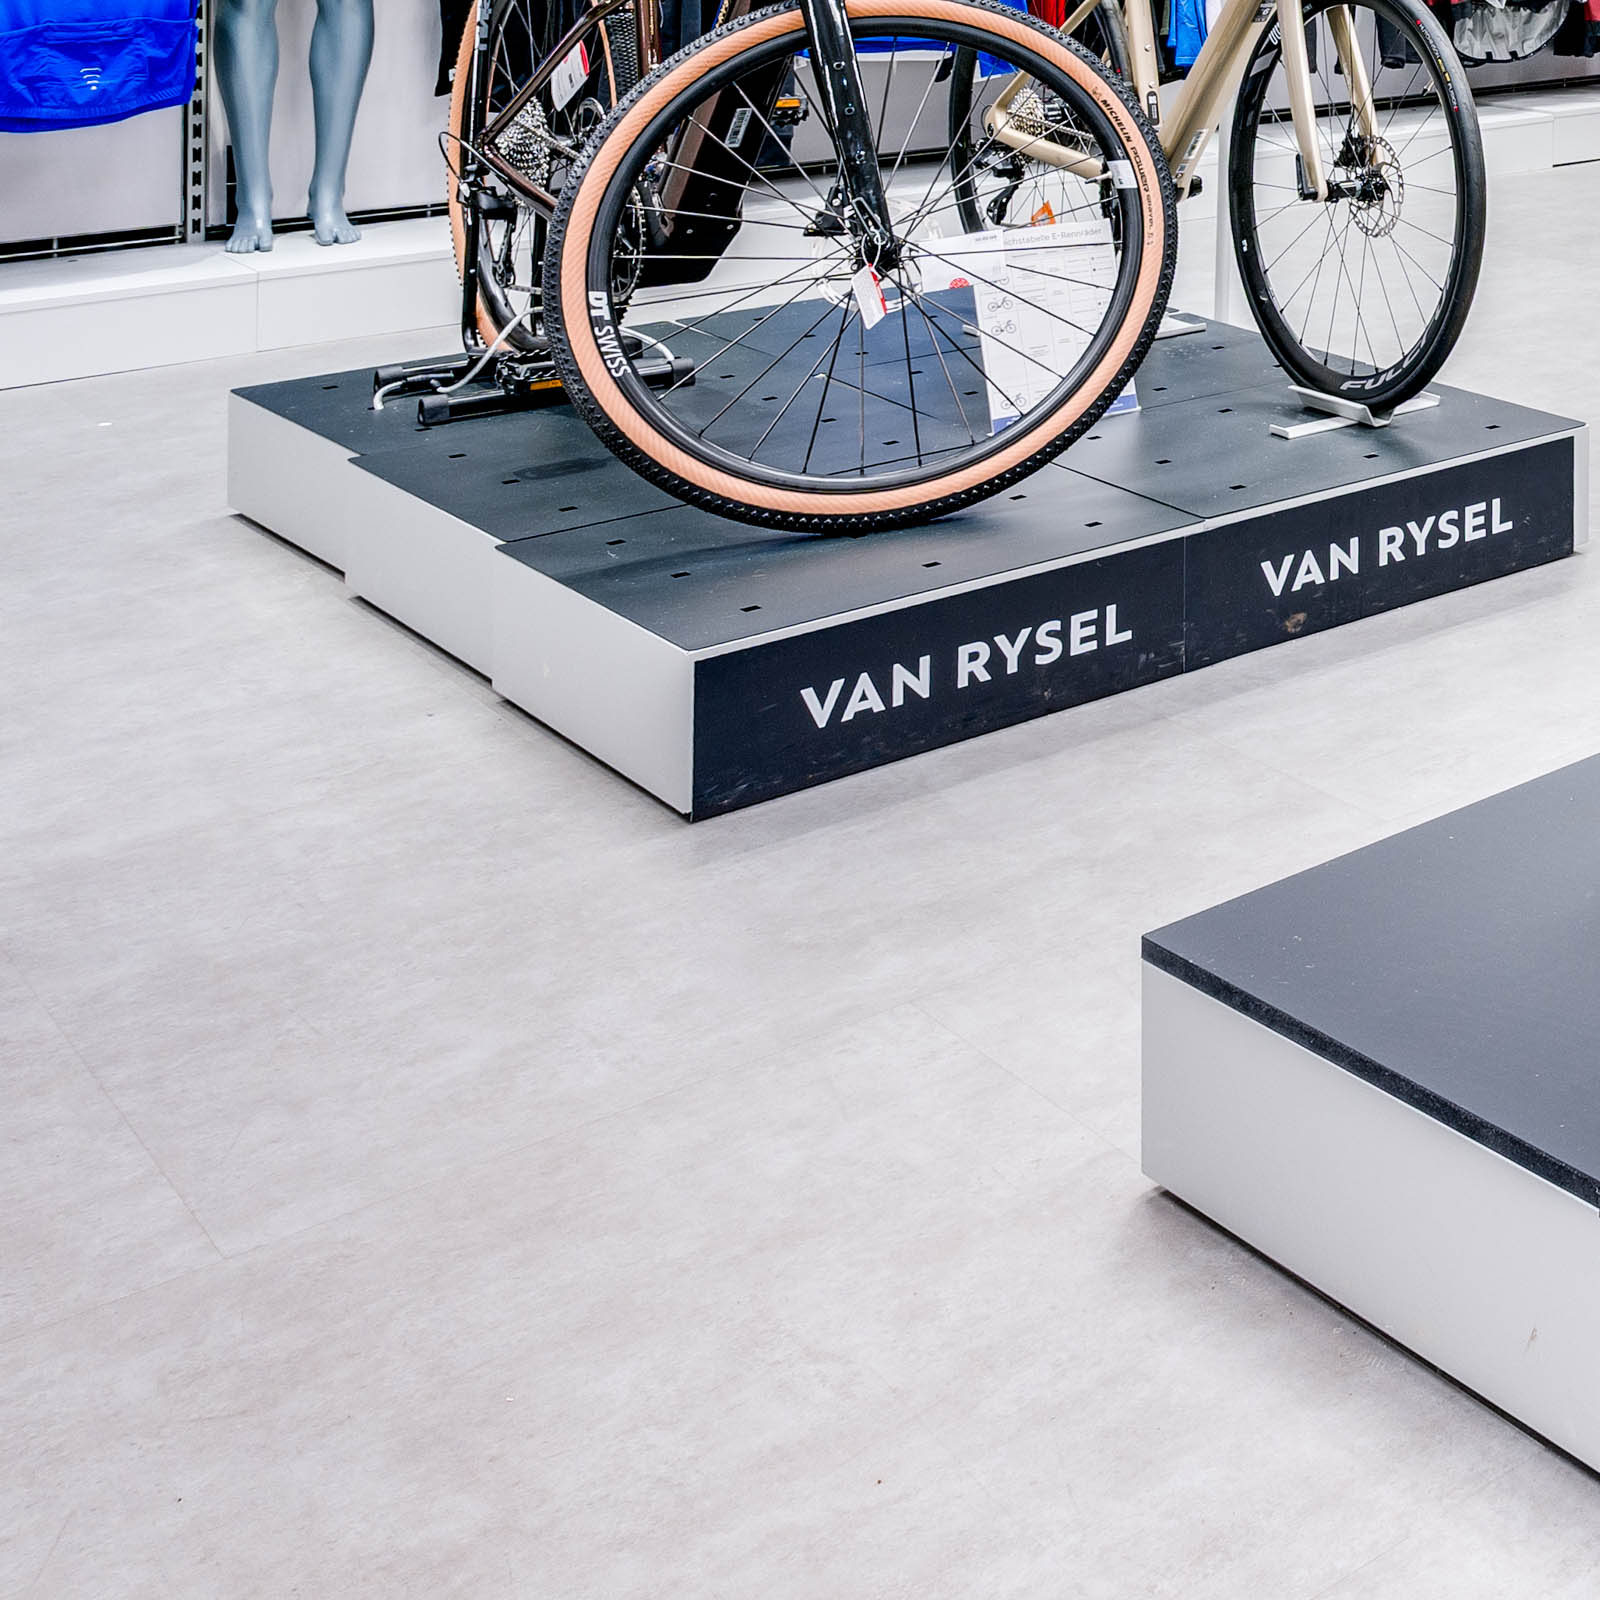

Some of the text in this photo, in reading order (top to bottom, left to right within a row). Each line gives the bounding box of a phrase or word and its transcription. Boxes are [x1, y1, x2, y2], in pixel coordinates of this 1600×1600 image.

[1101, 99, 1132, 142] MICHELIN
[1130, 146, 1150, 192] POWER
[588, 291, 632, 378] DT SWISS
[1260, 497, 1514, 597] VAN RYSEL
[801, 603, 1132, 729] VAN RYSEL
